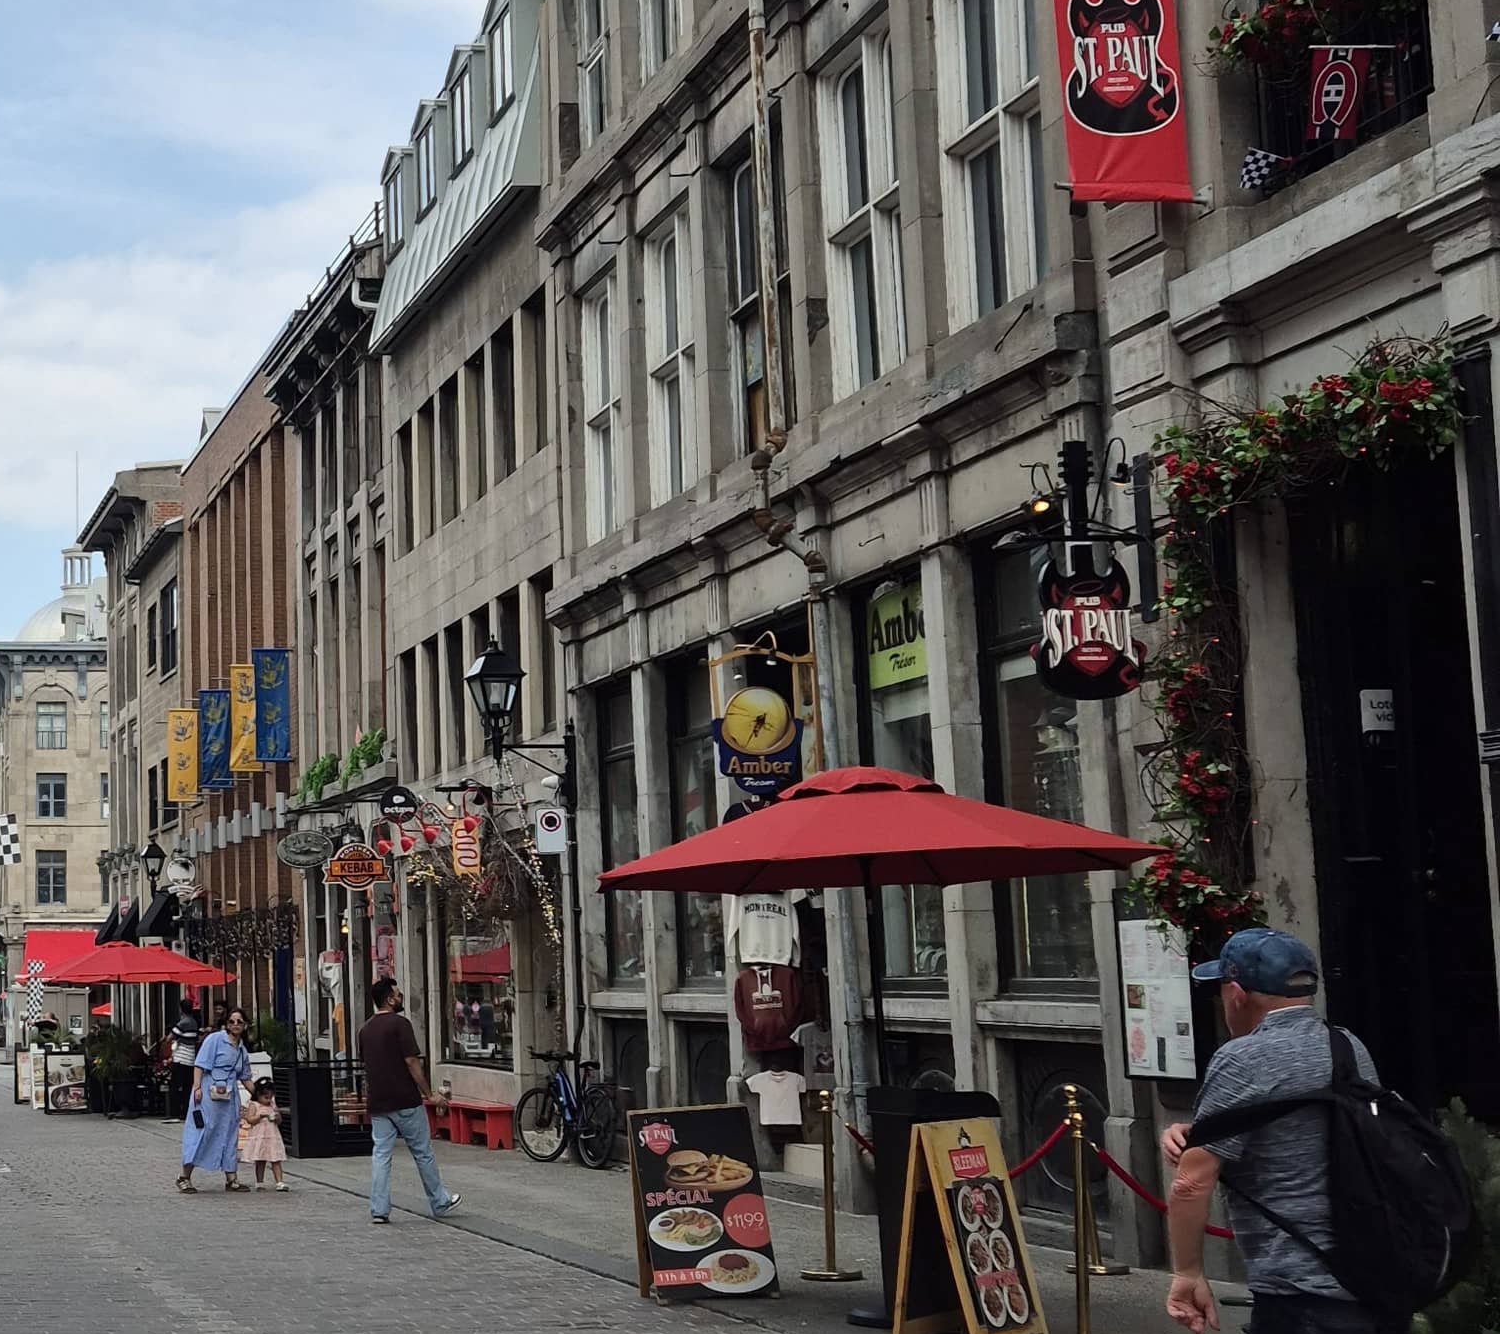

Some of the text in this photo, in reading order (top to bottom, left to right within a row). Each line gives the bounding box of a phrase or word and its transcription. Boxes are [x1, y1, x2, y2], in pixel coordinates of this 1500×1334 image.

[1100, 22, 1126, 34] PUB
[1074, 35, 1165, 98] ST. PAUL
[1075, 596, 1101, 606] PUB
[1046, 608, 1139, 668] ST. PAUL
[727, 755, 793, 775] Amber
[340, 862, 374, 873] KEBAB
[638, 1128, 679, 1147] ST. PAUL
[645, 1188, 714, 1208] SPÉCIAL
[659, 1272, 677, 1282] 11h
[690, 1270, 709, 1280] 16h
